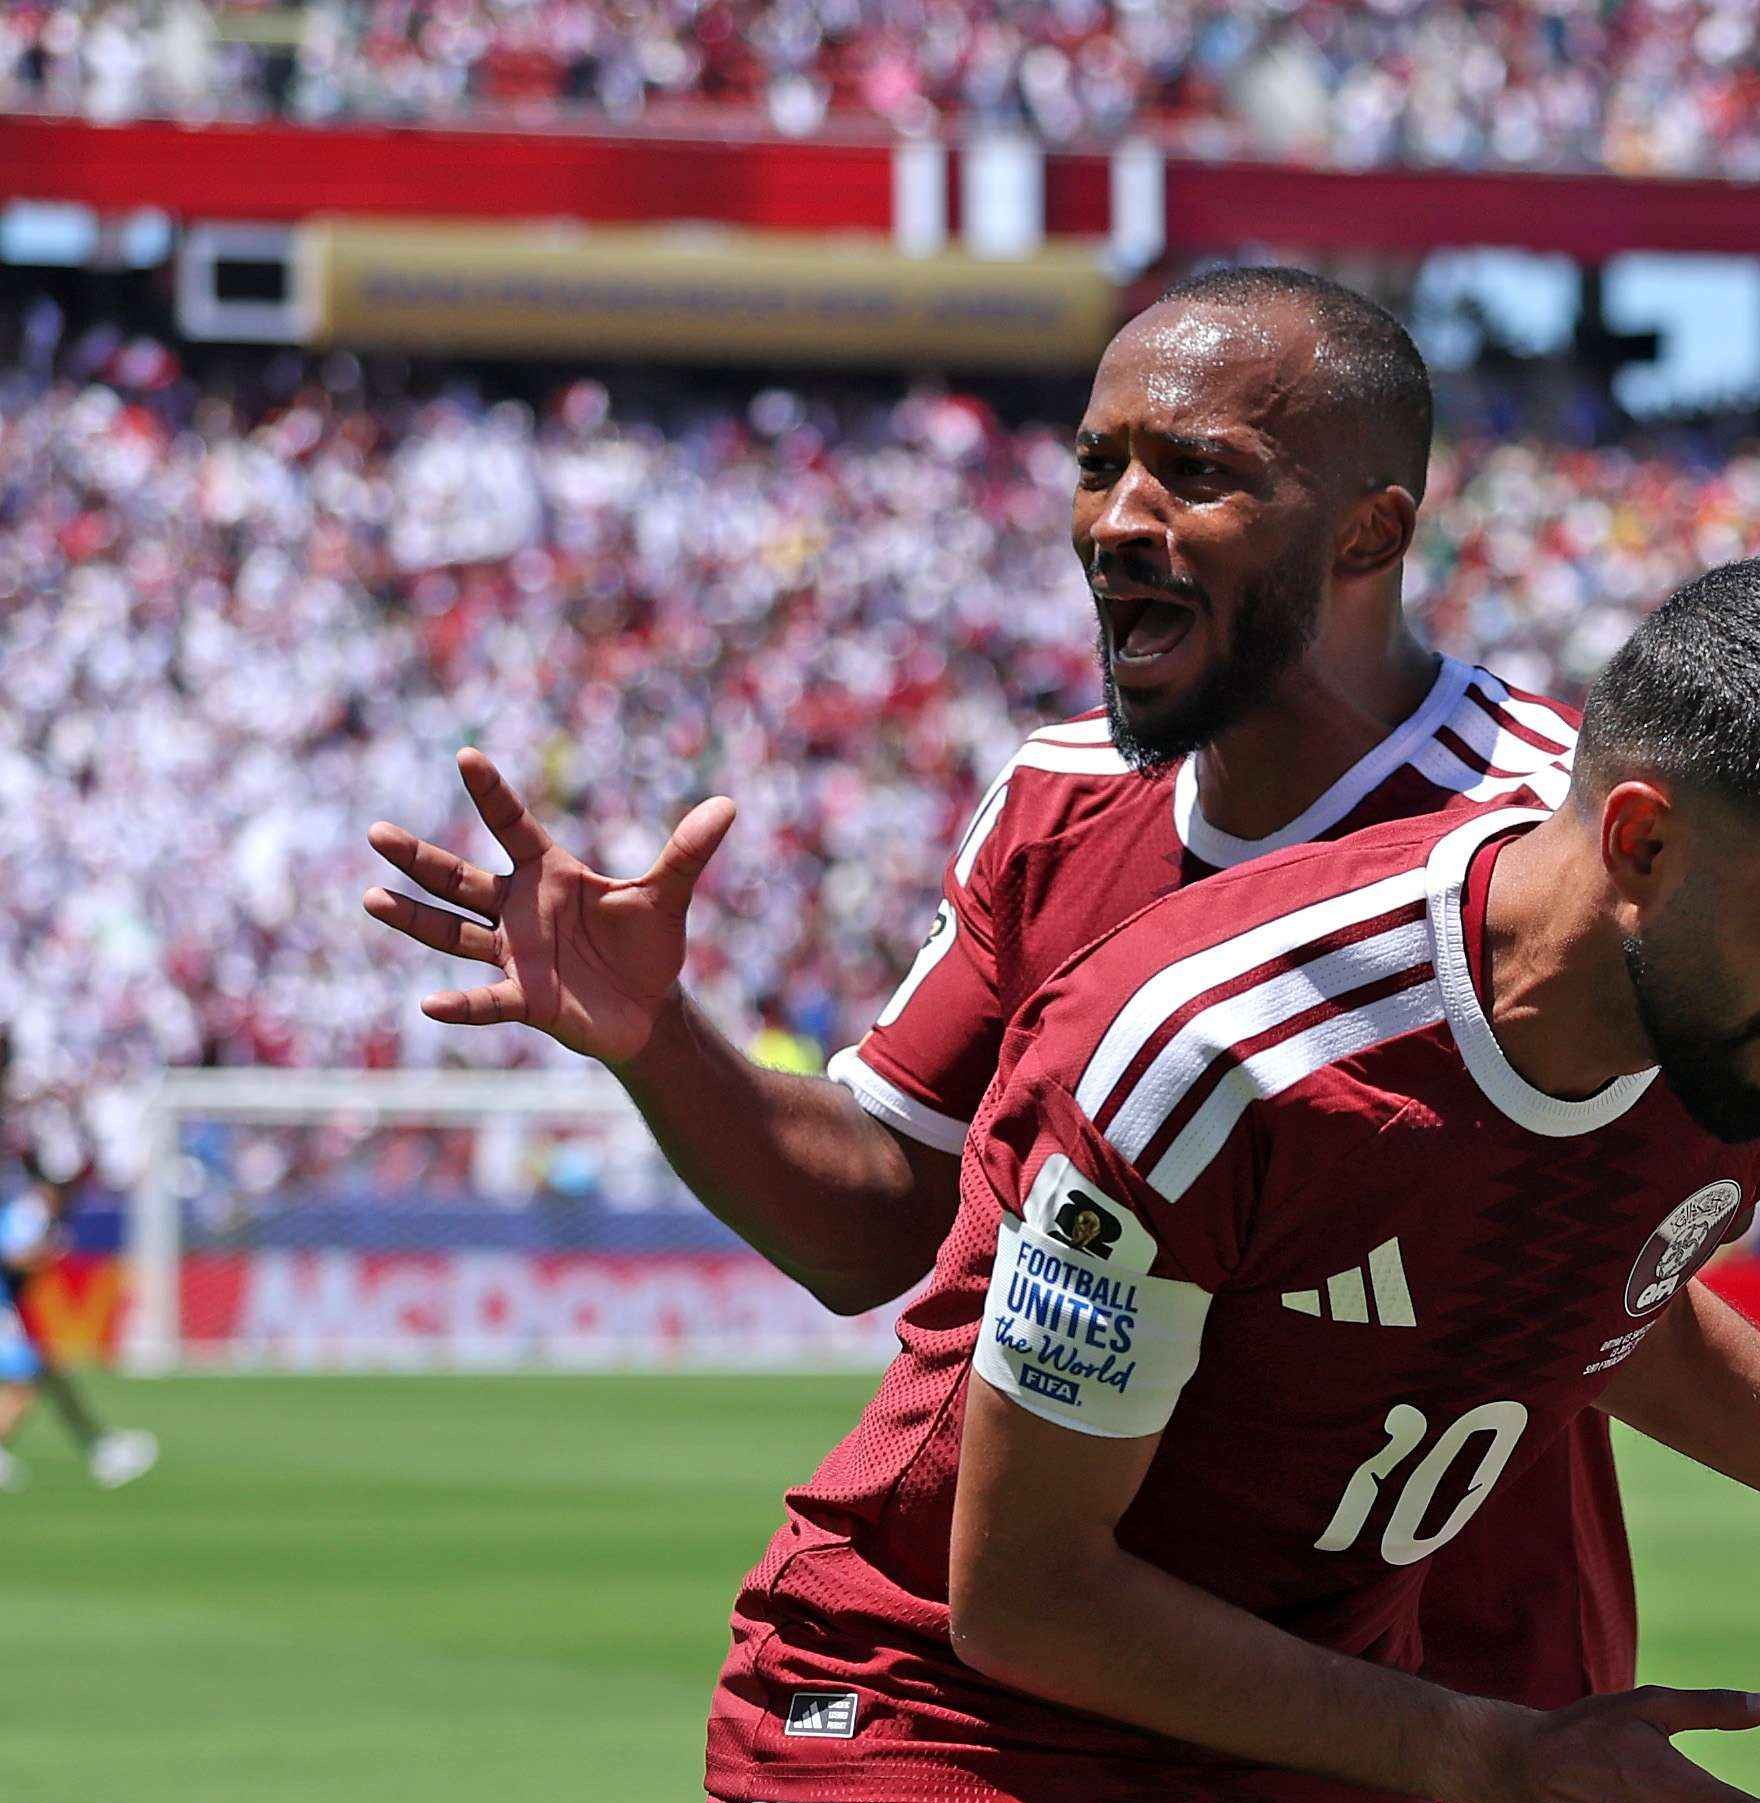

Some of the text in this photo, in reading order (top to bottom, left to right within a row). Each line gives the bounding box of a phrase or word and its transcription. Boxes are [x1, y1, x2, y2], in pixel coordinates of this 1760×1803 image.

[1006, 1271, 1135, 1354] UNITES
[1016, 1240, 1138, 1314] FOOTBALL
[994, 1315, 1137, 1394] the World
[1021, 1365, 1079, 1401] FIFA
[1313, 1401, 1528, 1566] 10
